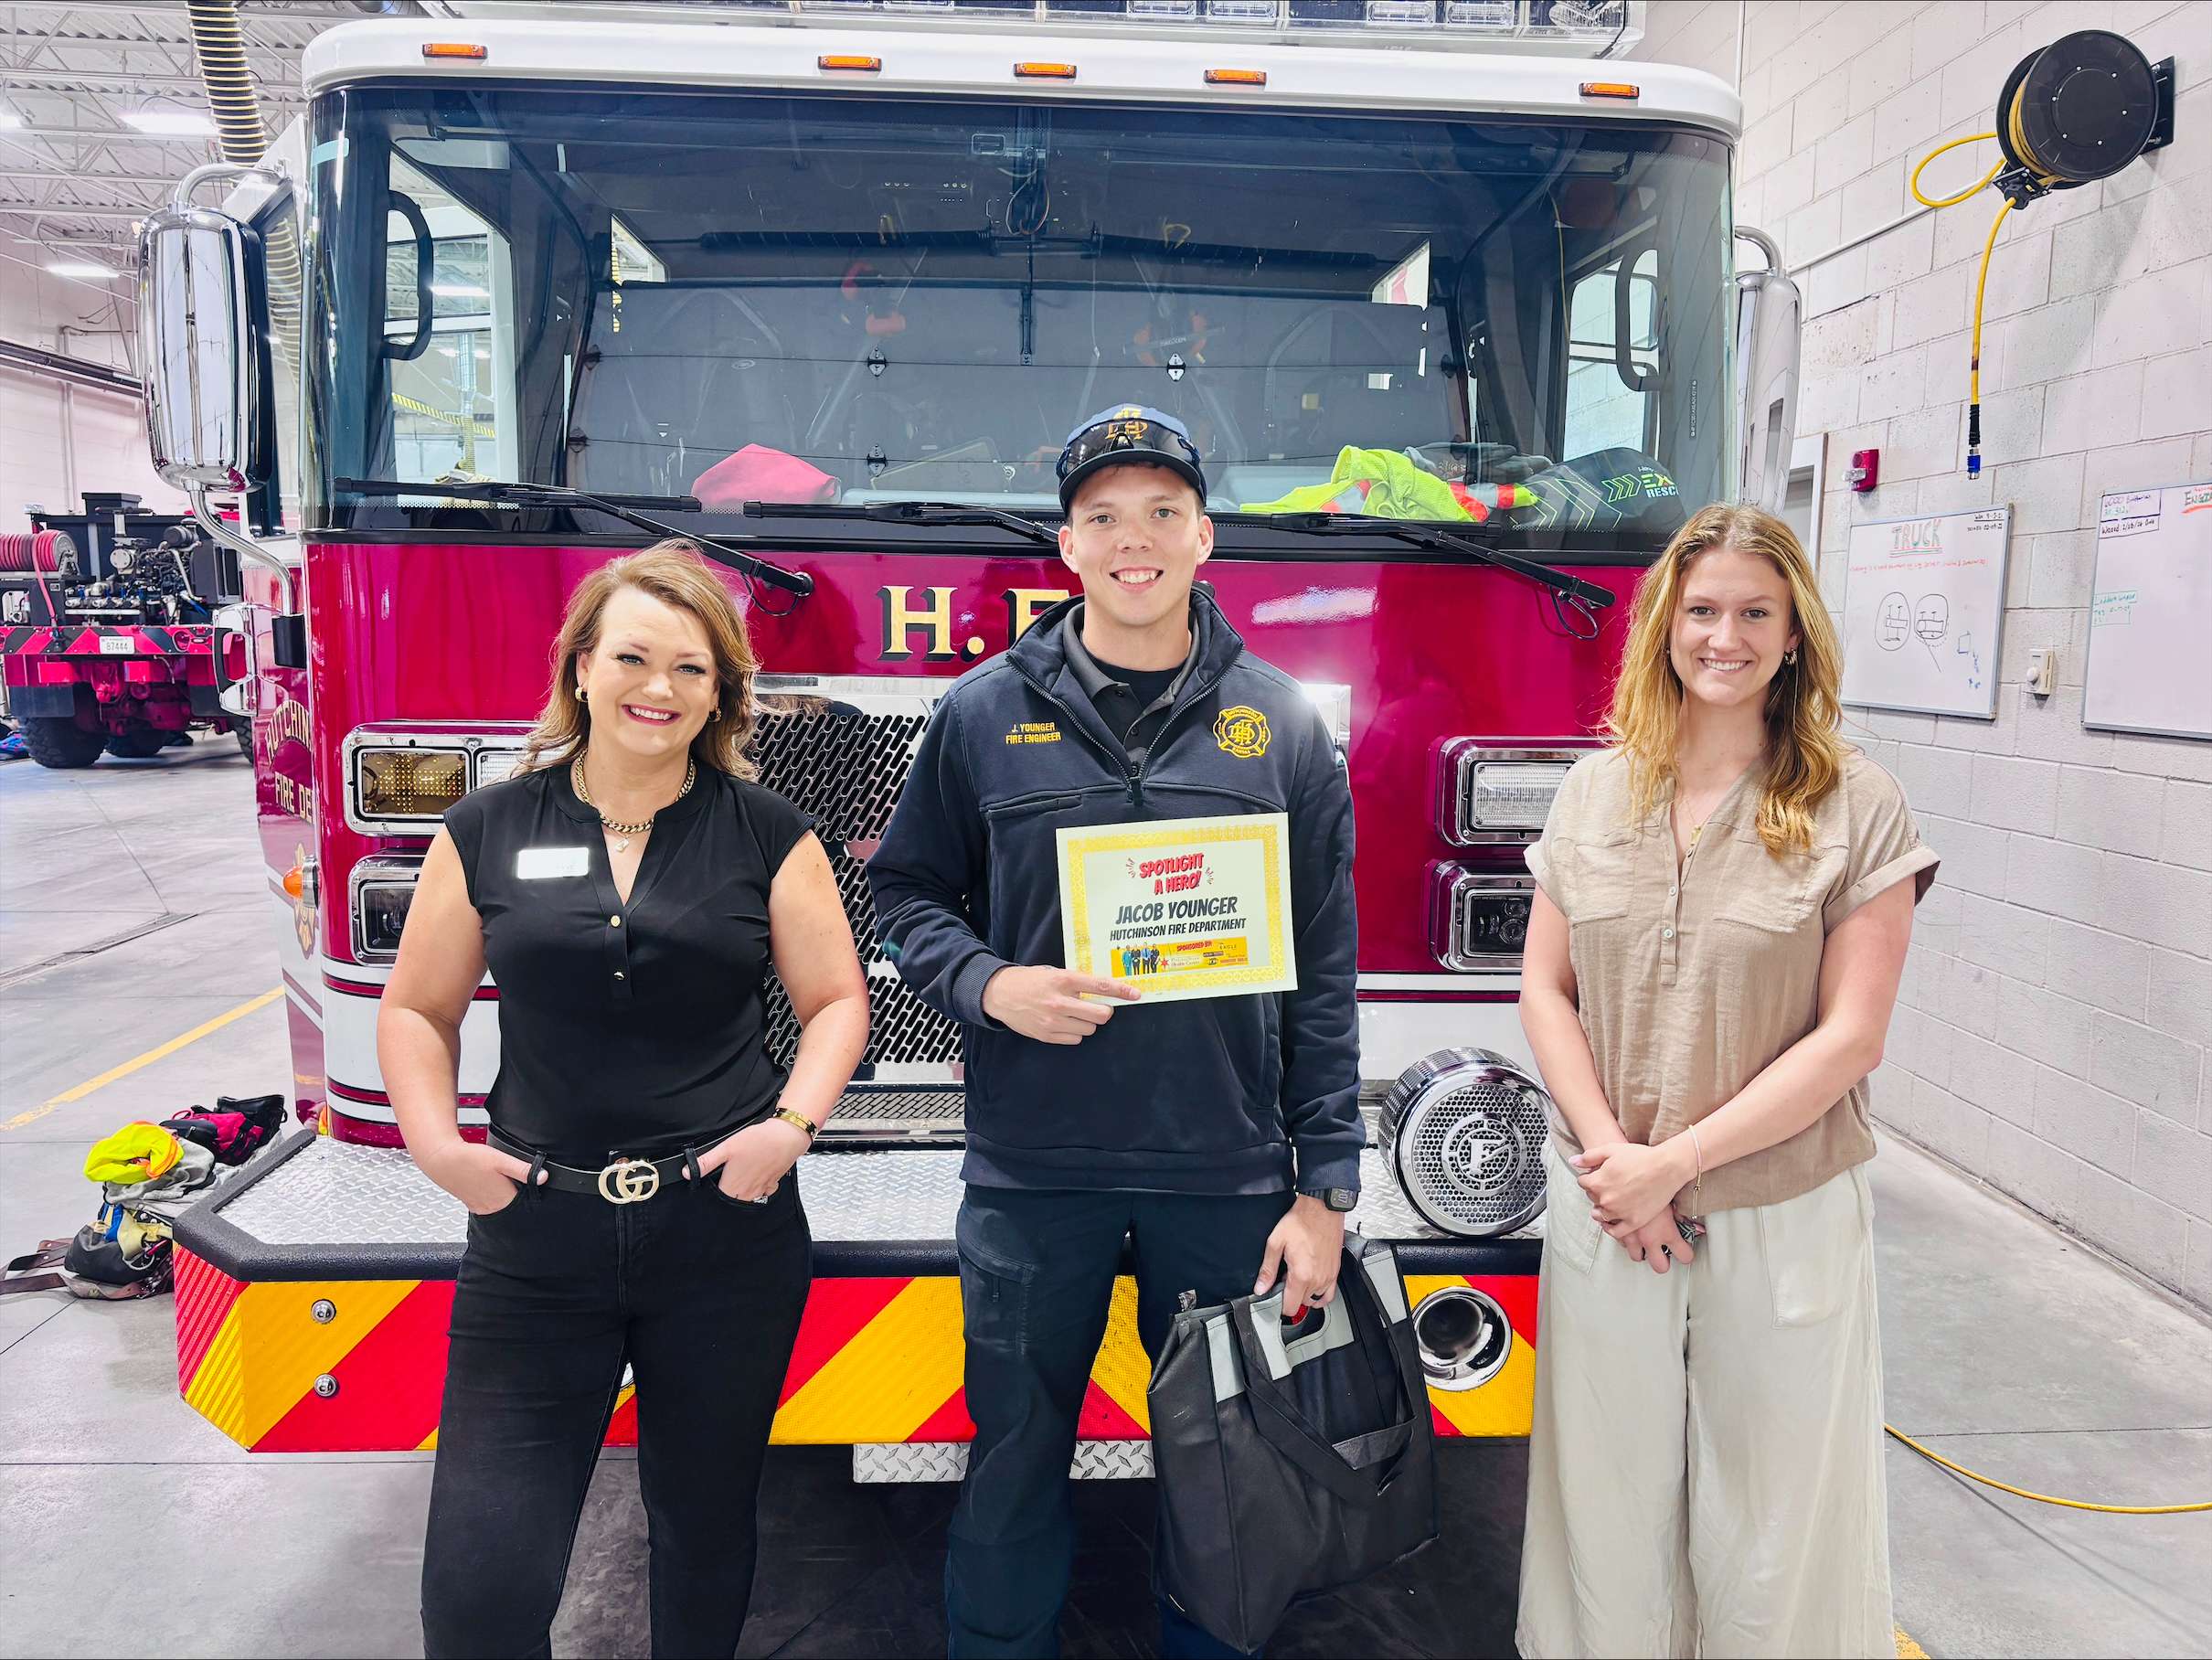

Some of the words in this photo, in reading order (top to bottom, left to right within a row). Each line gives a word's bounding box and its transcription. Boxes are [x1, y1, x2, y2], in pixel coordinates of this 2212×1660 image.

[1891, 519, 1941, 549] TRUCK
[1005, 734, 1023, 745] FIRE
[1024, 732, 1061, 743] ENGINEER
[1020, 722, 1055, 732] YOUNGER
[274, 771, 294, 814] FIRE
[1139, 853, 1204, 878] SPOTLIGHT
[1154, 879, 1164, 895] A
[1165, 870, 1202, 893] HERO!
[1115, 902, 1164, 924] JACOB
[1168, 897, 1238, 919] YOUNGER
[1110, 925, 1166, 941] HUTCHINSON
[1168, 923, 1186, 935] FIRE
[1188, 918, 1247, 933] DEPARTMENT
[1177, 942, 1205, 952] SPONSORED
